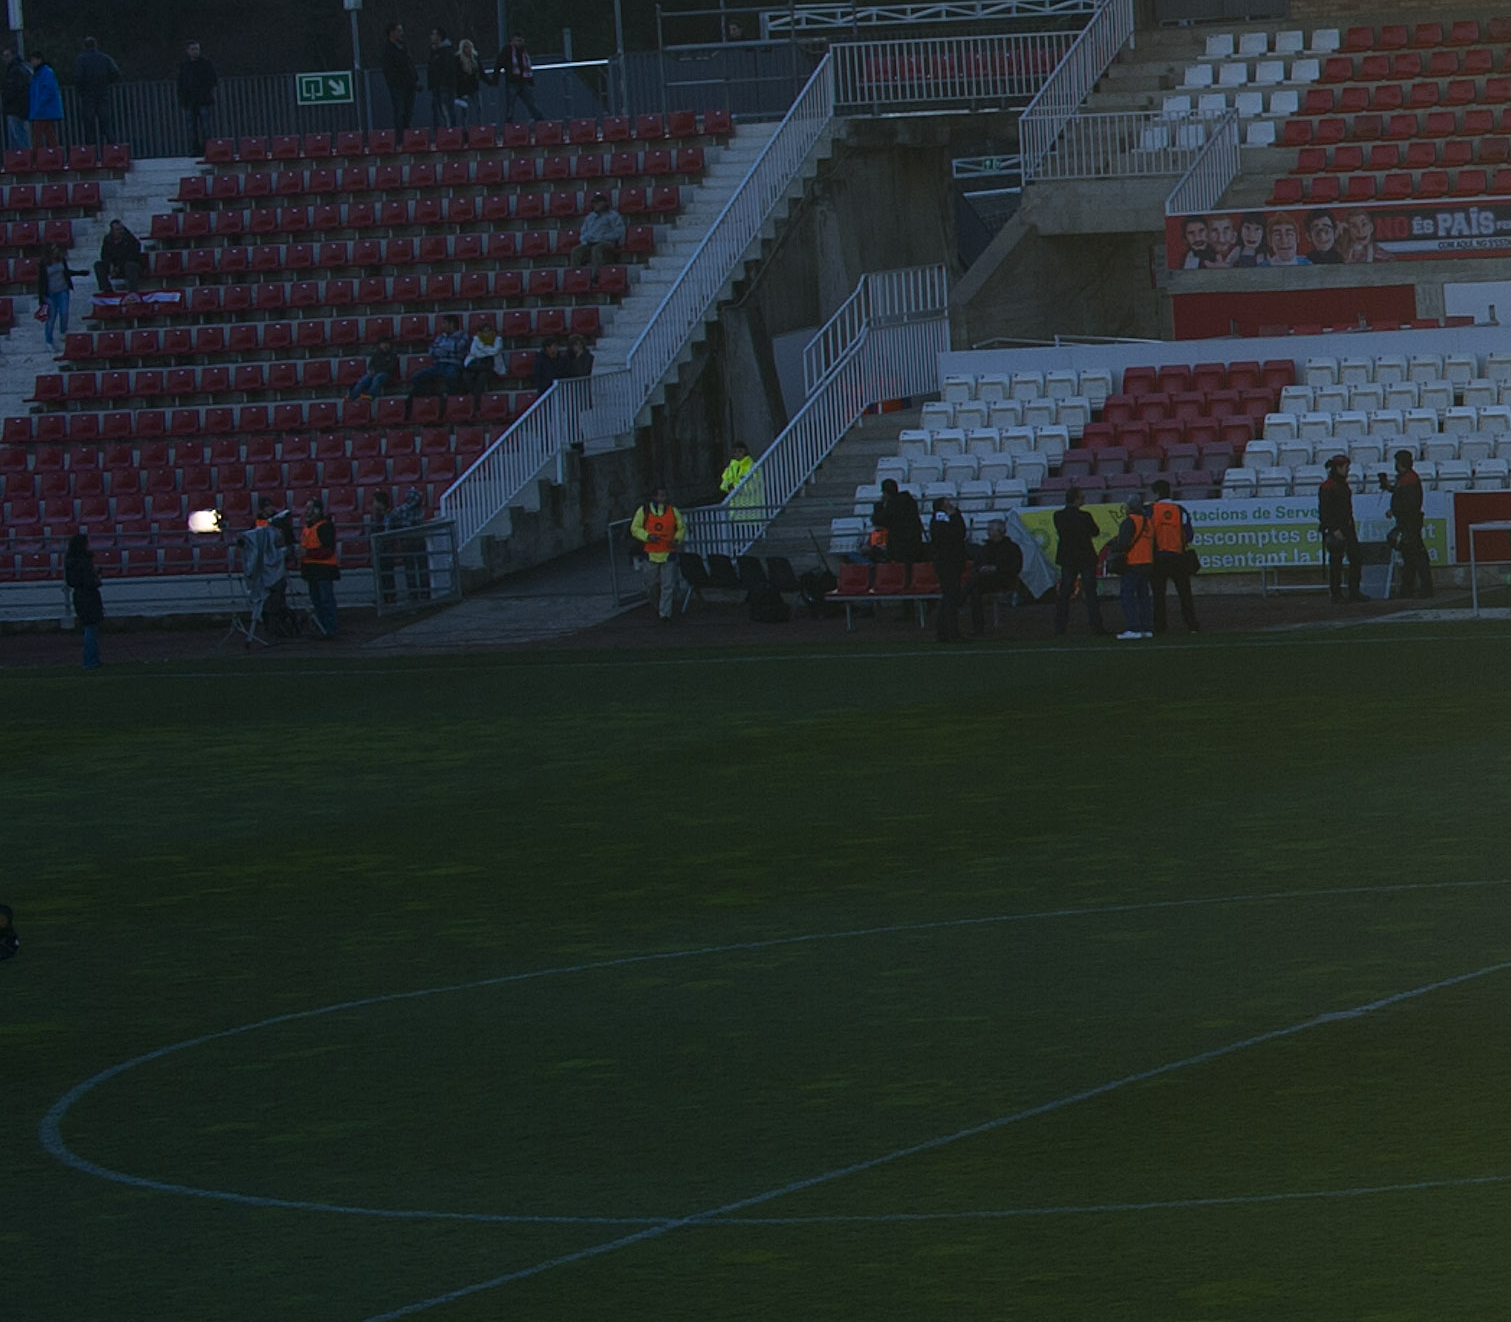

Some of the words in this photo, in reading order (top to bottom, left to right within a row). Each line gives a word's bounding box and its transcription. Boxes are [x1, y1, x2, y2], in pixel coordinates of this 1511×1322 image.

[1188, 508, 1250, 522] tacions
[1252, 506, 1271, 520] de
[1275, 505, 1319, 519] Serve
[1191, 528, 1299, 547] escomptes
[1200, 550, 1288, 568] esentant
